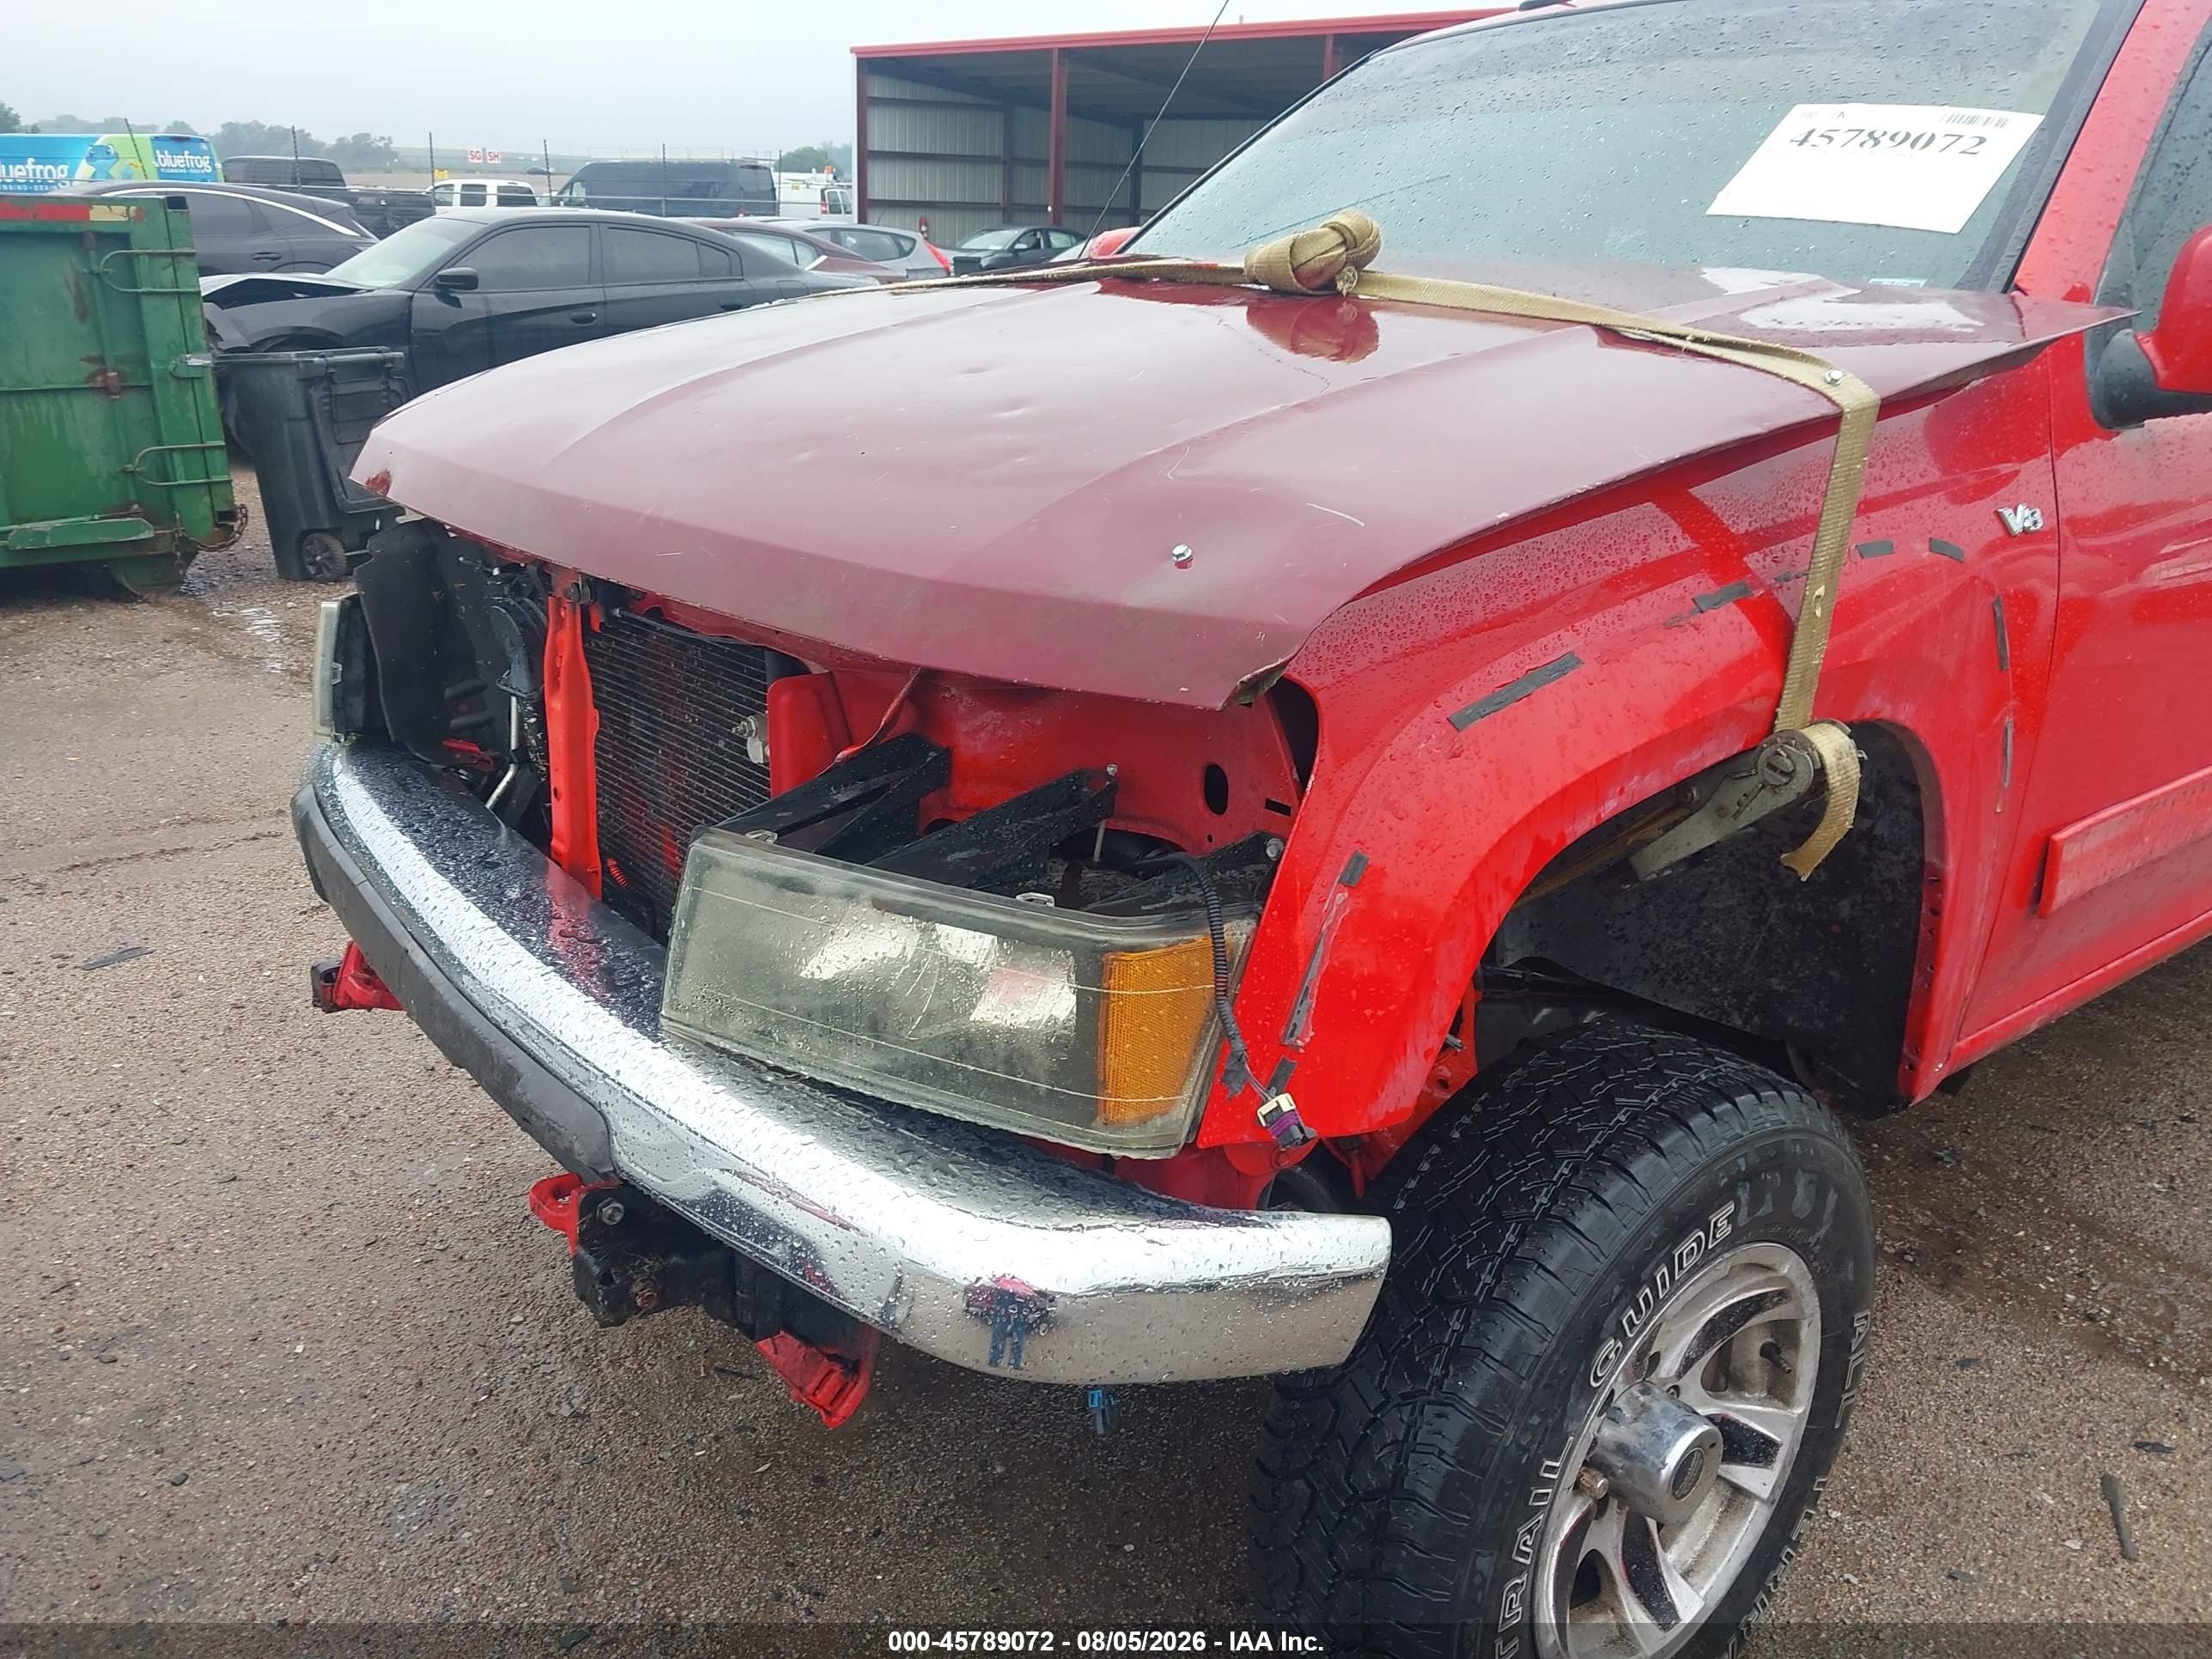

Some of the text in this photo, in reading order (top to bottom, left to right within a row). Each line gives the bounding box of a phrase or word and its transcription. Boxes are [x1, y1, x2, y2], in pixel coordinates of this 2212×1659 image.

[1790, 127, 1987, 155] 45789072
[0, 157, 70, 188] uefrog
[155, 149, 212, 173] bluefrog
[1494, 1200, 1735, 1659] TRAIL GUIDE
